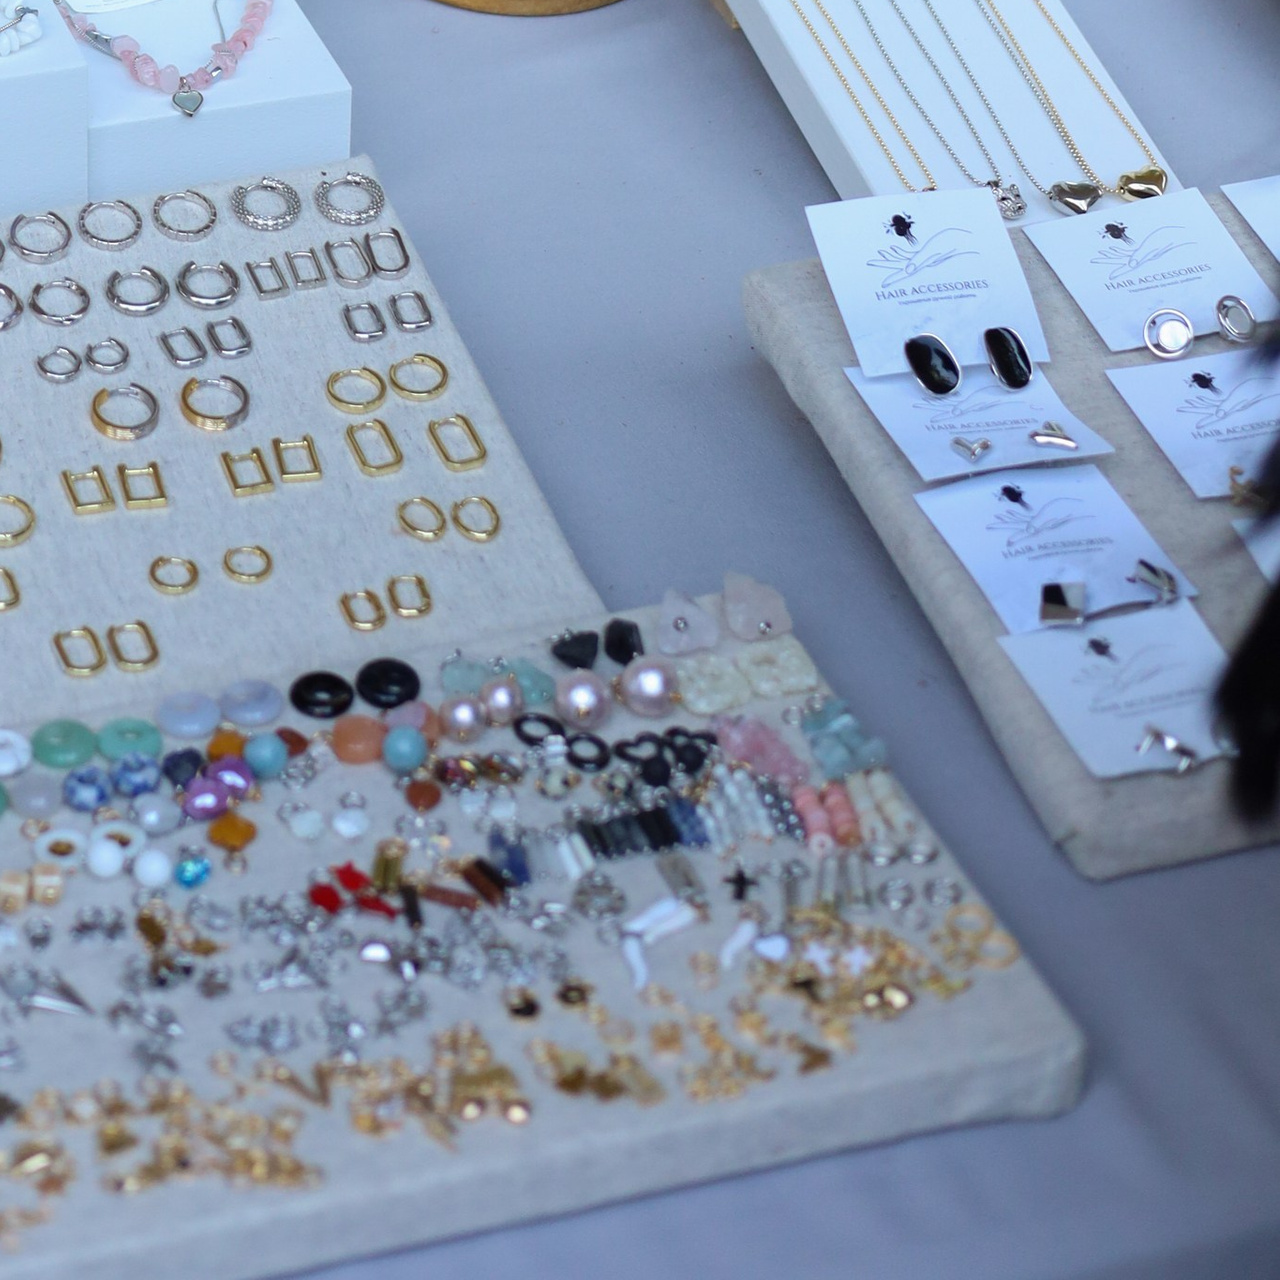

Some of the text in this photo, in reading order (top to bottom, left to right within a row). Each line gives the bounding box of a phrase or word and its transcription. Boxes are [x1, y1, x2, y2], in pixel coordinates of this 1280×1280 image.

[1104, 279, 1137, 291] HAIR
[1138, 263, 1212, 284] ACCESSORIES
[875, 288, 908, 301] HAIR
[911, 279, 989, 295] ACCESSORIES
[924, 423, 958, 432] HAIR
[1191, 429, 1222, 440] HAIR
